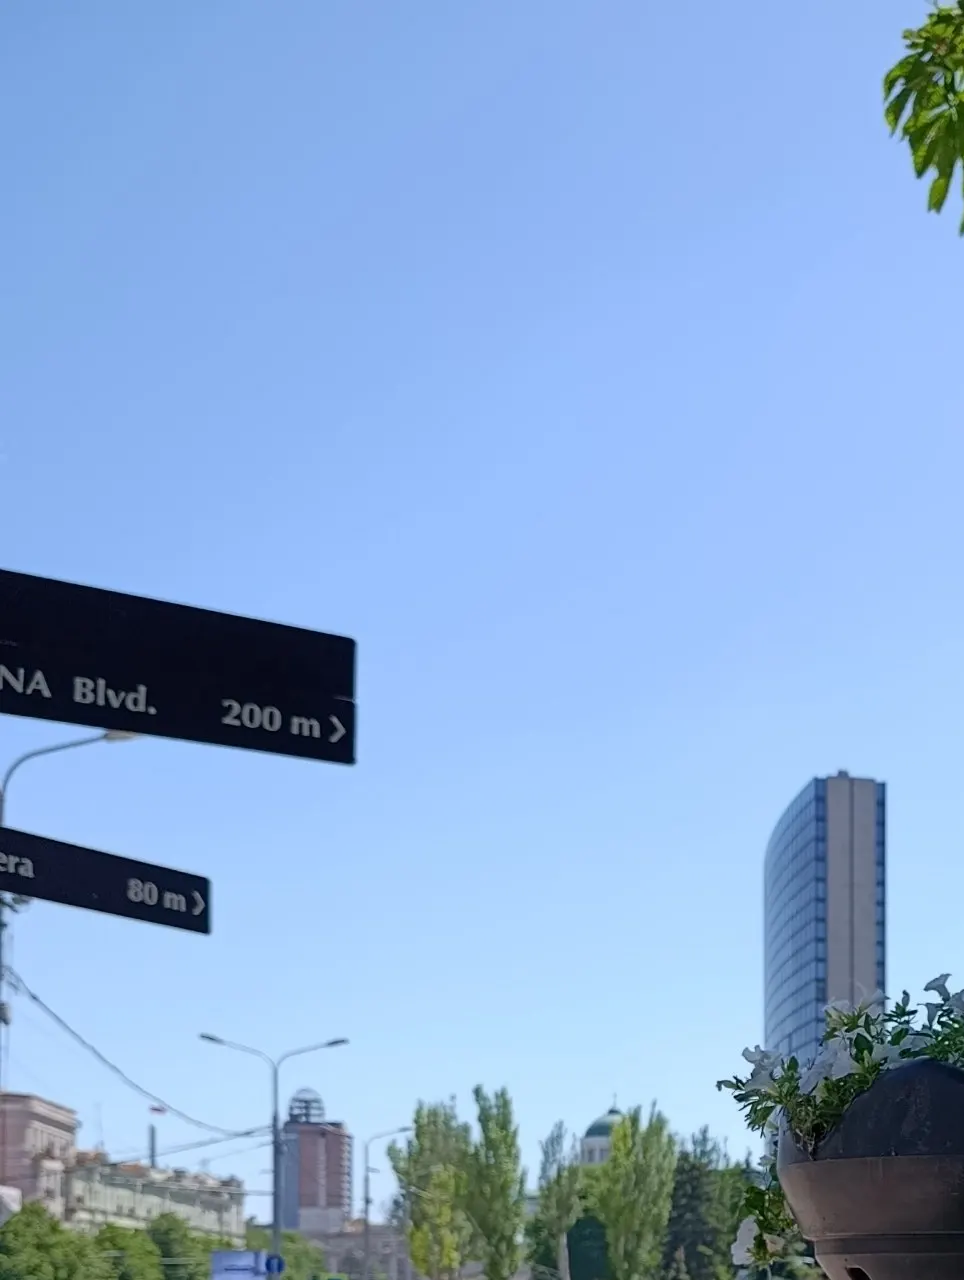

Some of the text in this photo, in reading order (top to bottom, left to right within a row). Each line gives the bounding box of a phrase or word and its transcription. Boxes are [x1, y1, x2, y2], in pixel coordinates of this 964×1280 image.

[73, 676, 157, 715] Blvd.
[221, 698, 282, 732] 200
[290, 715, 321, 738] m
[127, 877, 158, 906] 80
[163, 891, 187, 912] m
